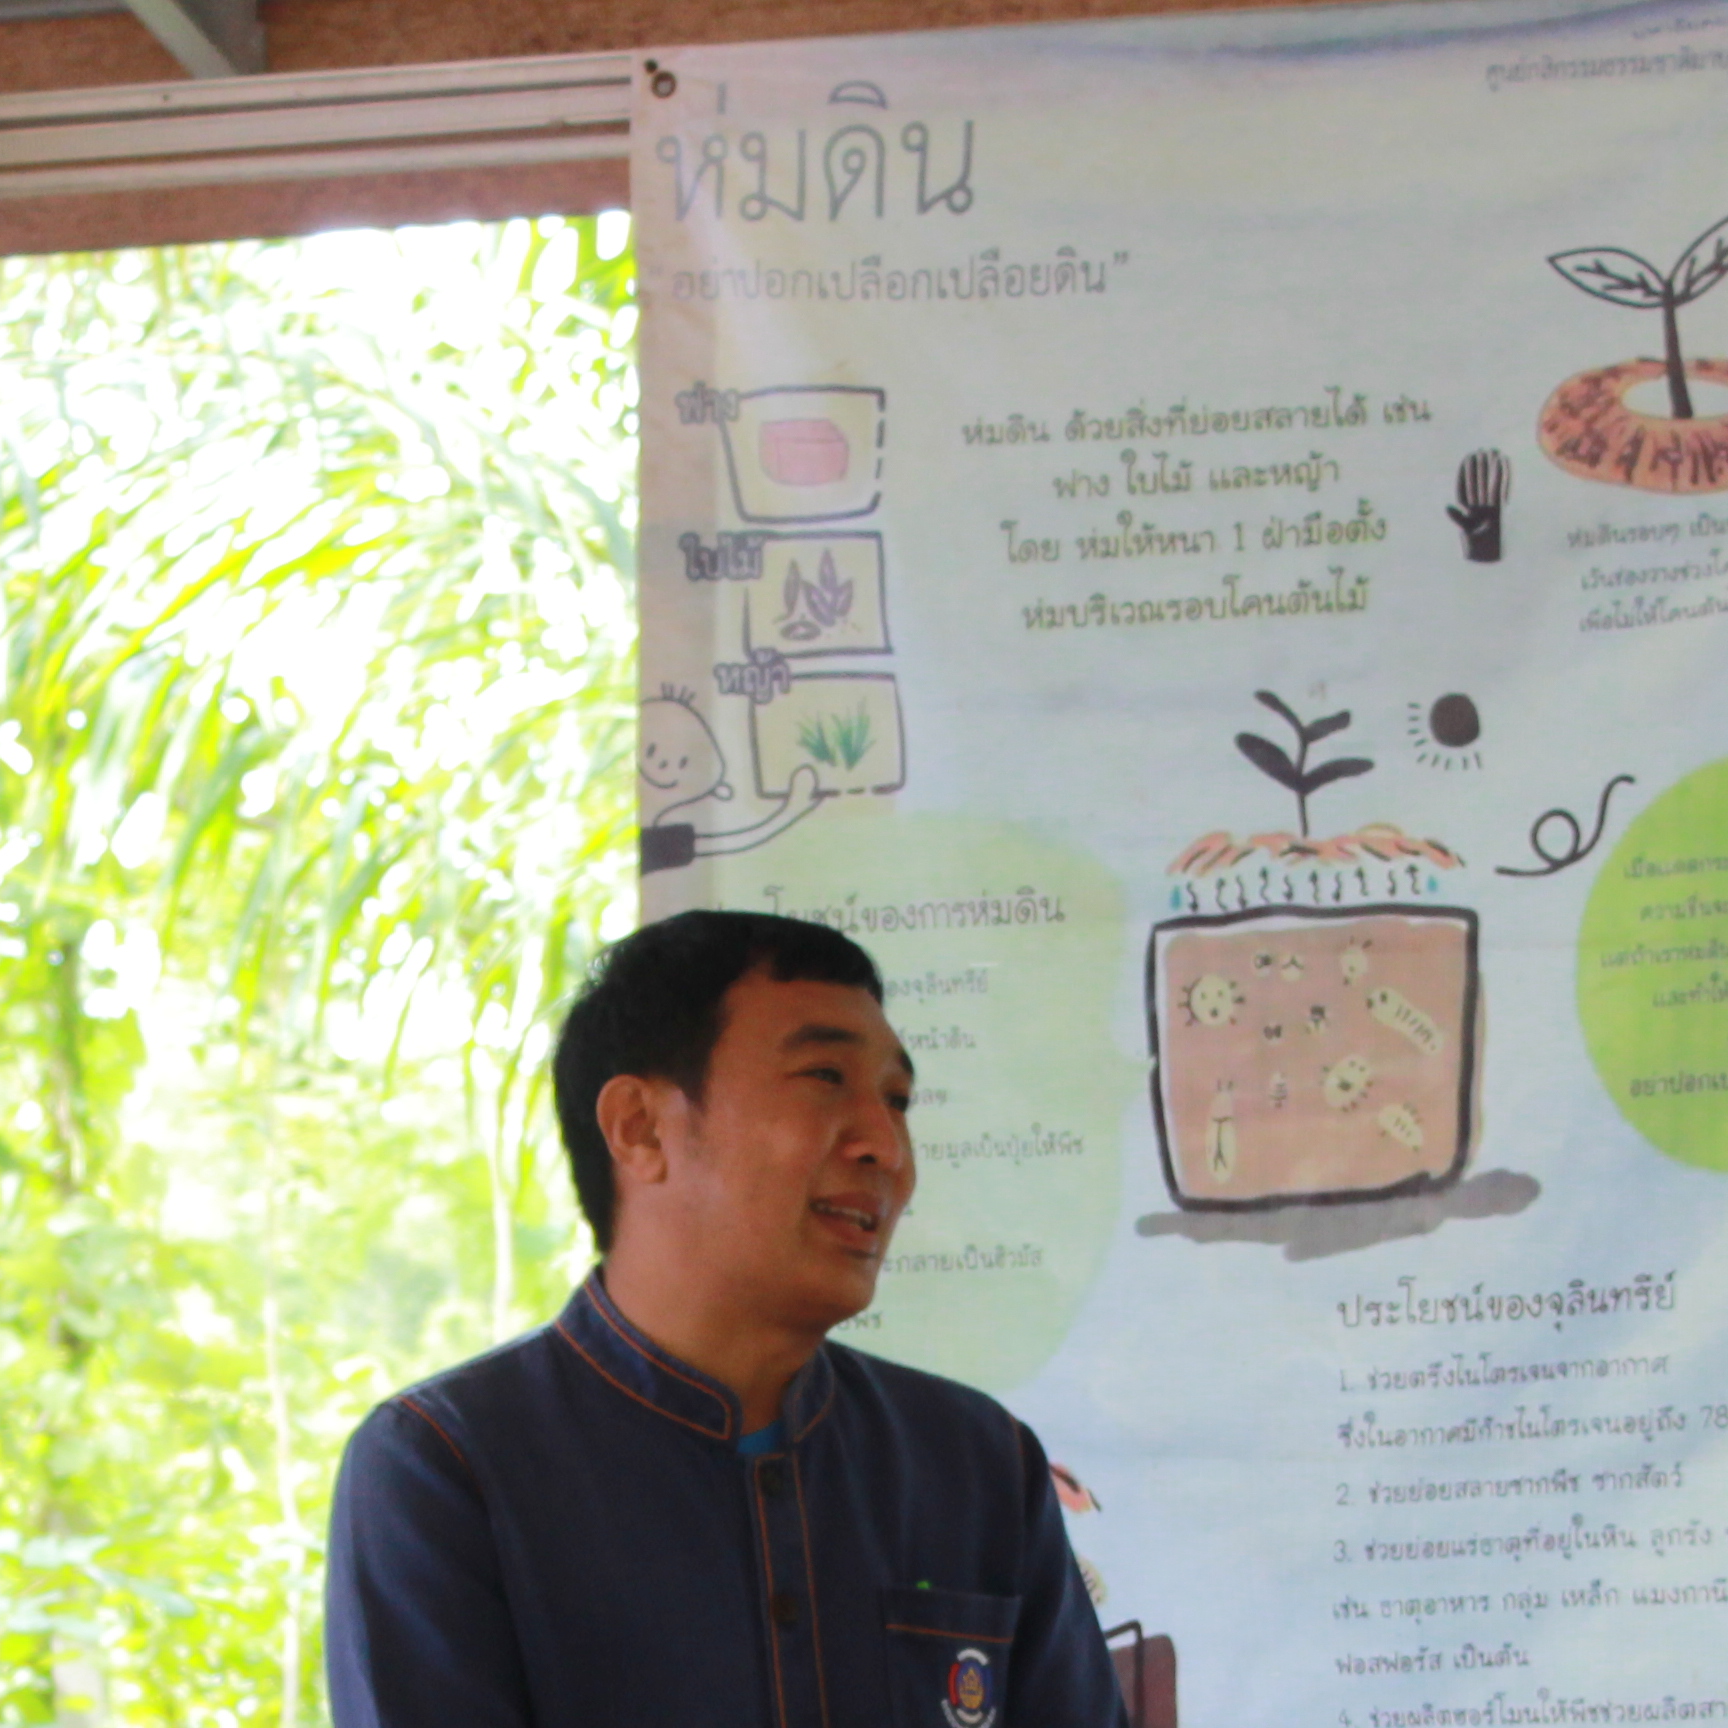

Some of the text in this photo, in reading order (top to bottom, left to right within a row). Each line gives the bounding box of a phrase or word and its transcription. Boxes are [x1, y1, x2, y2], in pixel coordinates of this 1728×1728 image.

[656, 80, 975, 222] ห่มดิน
[961, 411, 1051, 447] ห่มดิน
[1383, 392, 1432, 426] เช่น
[1052, 447, 1341, 500] ฟาง ใบไม้ และหญ้า
[1000, 520, 1061, 565] โดย
[1076, 510, 1216, 562] ห่มให้หนา
[1336, 1269, 1677, 1333] ประโยชน์ของจุลินทรีย์
